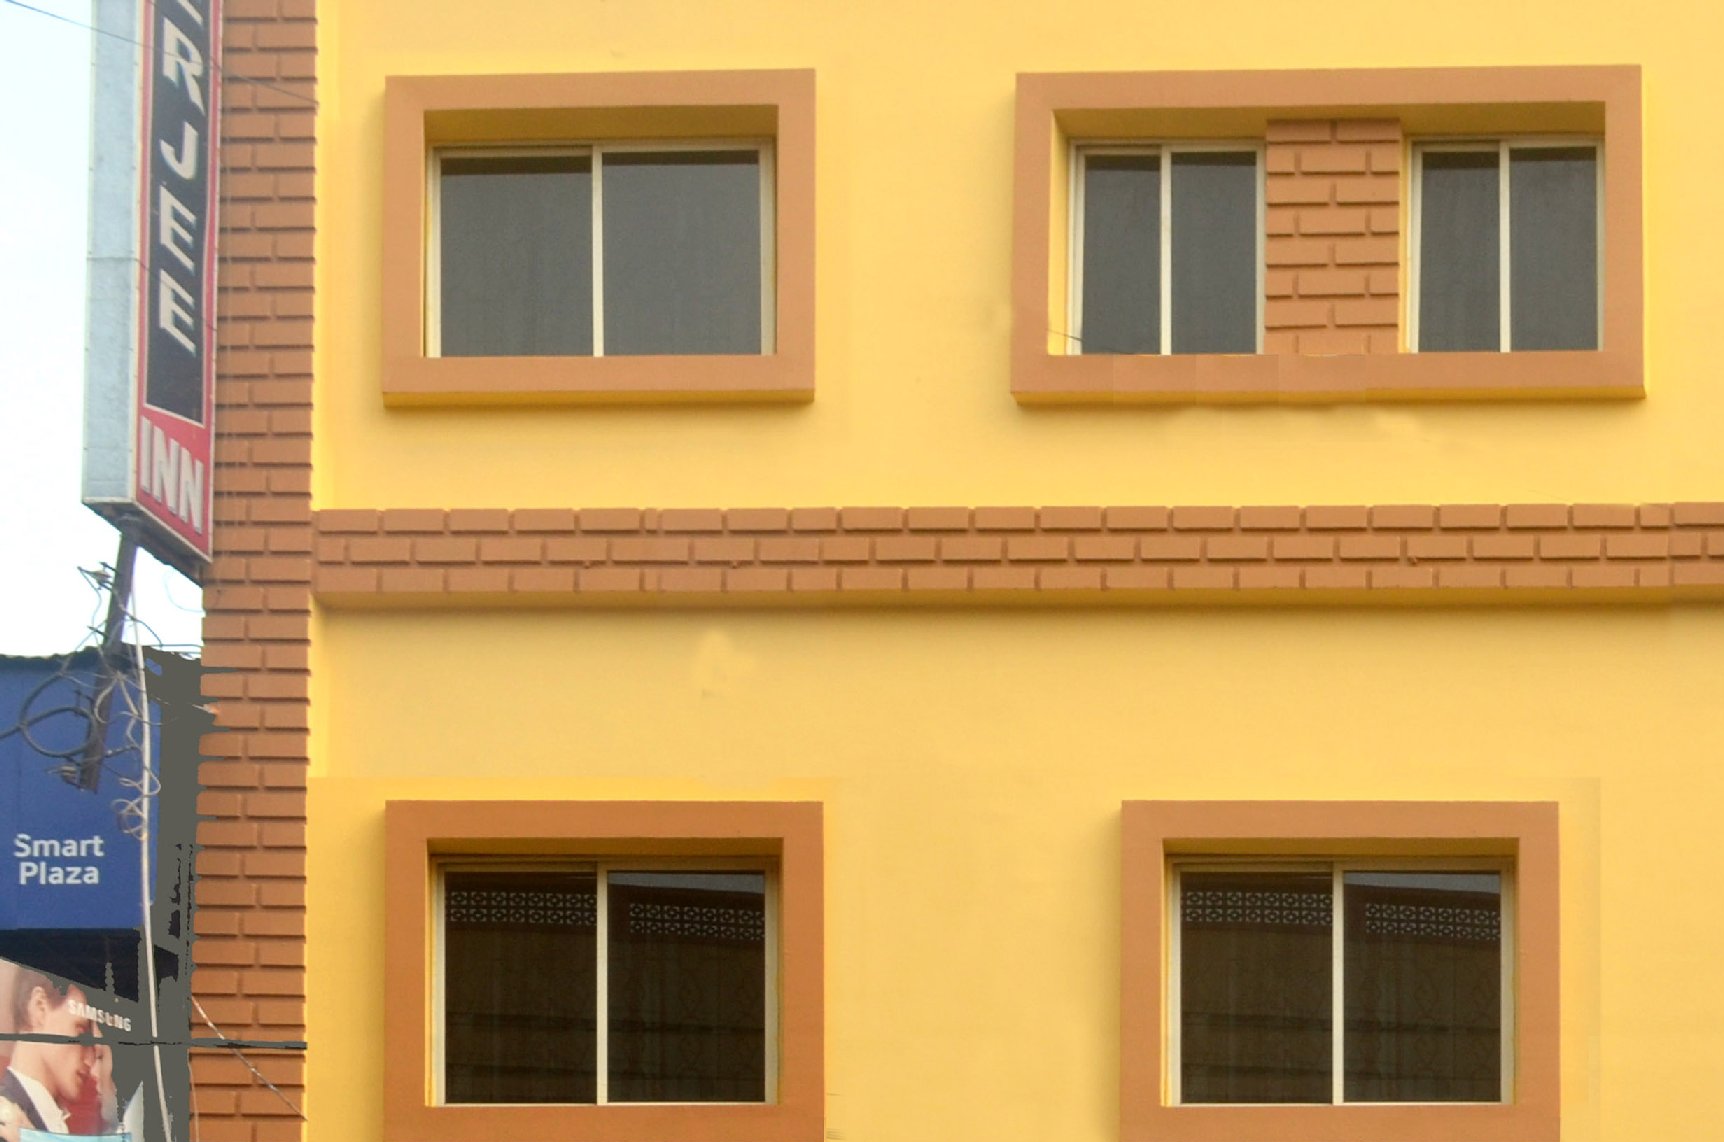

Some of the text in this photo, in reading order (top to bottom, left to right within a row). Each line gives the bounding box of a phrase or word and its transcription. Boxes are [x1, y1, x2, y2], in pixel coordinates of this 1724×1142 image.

[140, 416, 203, 535] INN
[14, 833, 104, 857] Smart
[19, 861, 99, 884] Plaza
